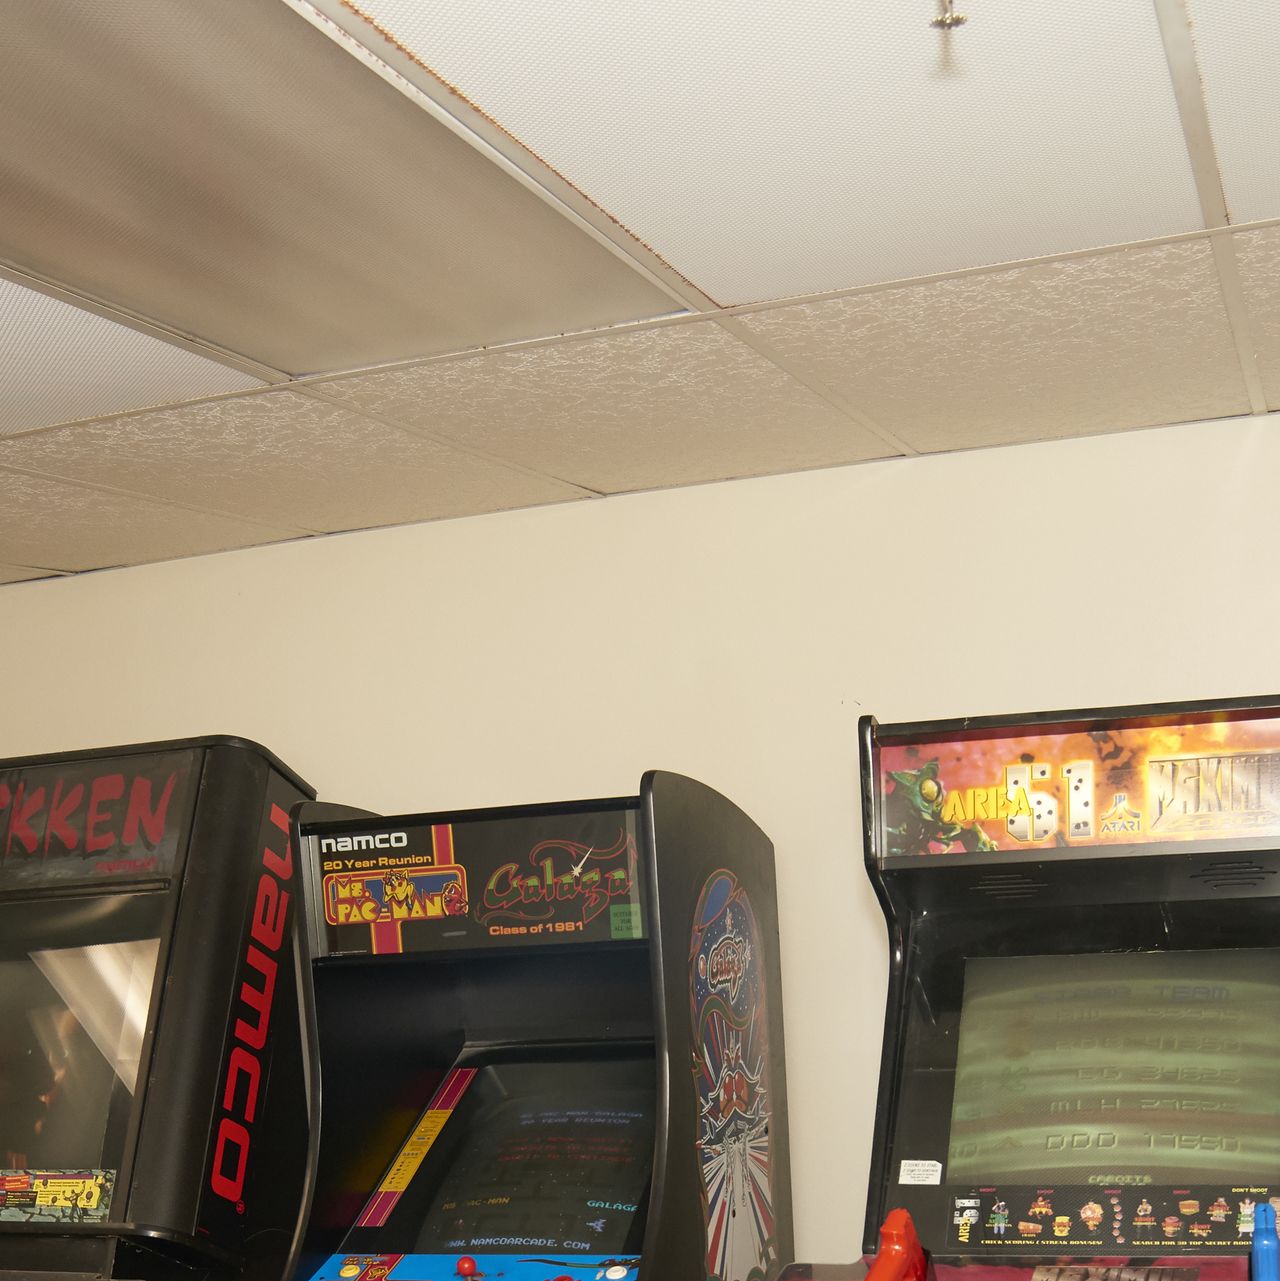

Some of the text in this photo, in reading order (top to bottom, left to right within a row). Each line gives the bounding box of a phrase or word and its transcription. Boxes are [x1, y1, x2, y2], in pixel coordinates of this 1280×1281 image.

[942, 758, 1097, 844] AREA 51
[1102, 818, 1142, 832] ATARI
[321, 831, 408, 853] namco
[323, 853, 432, 871] 20 Year Reunion
[336, 889, 445, 923] PAC-MAN
[489, 921, 584, 936] Class of 1981
[211, 802, 294, 1205] namco
